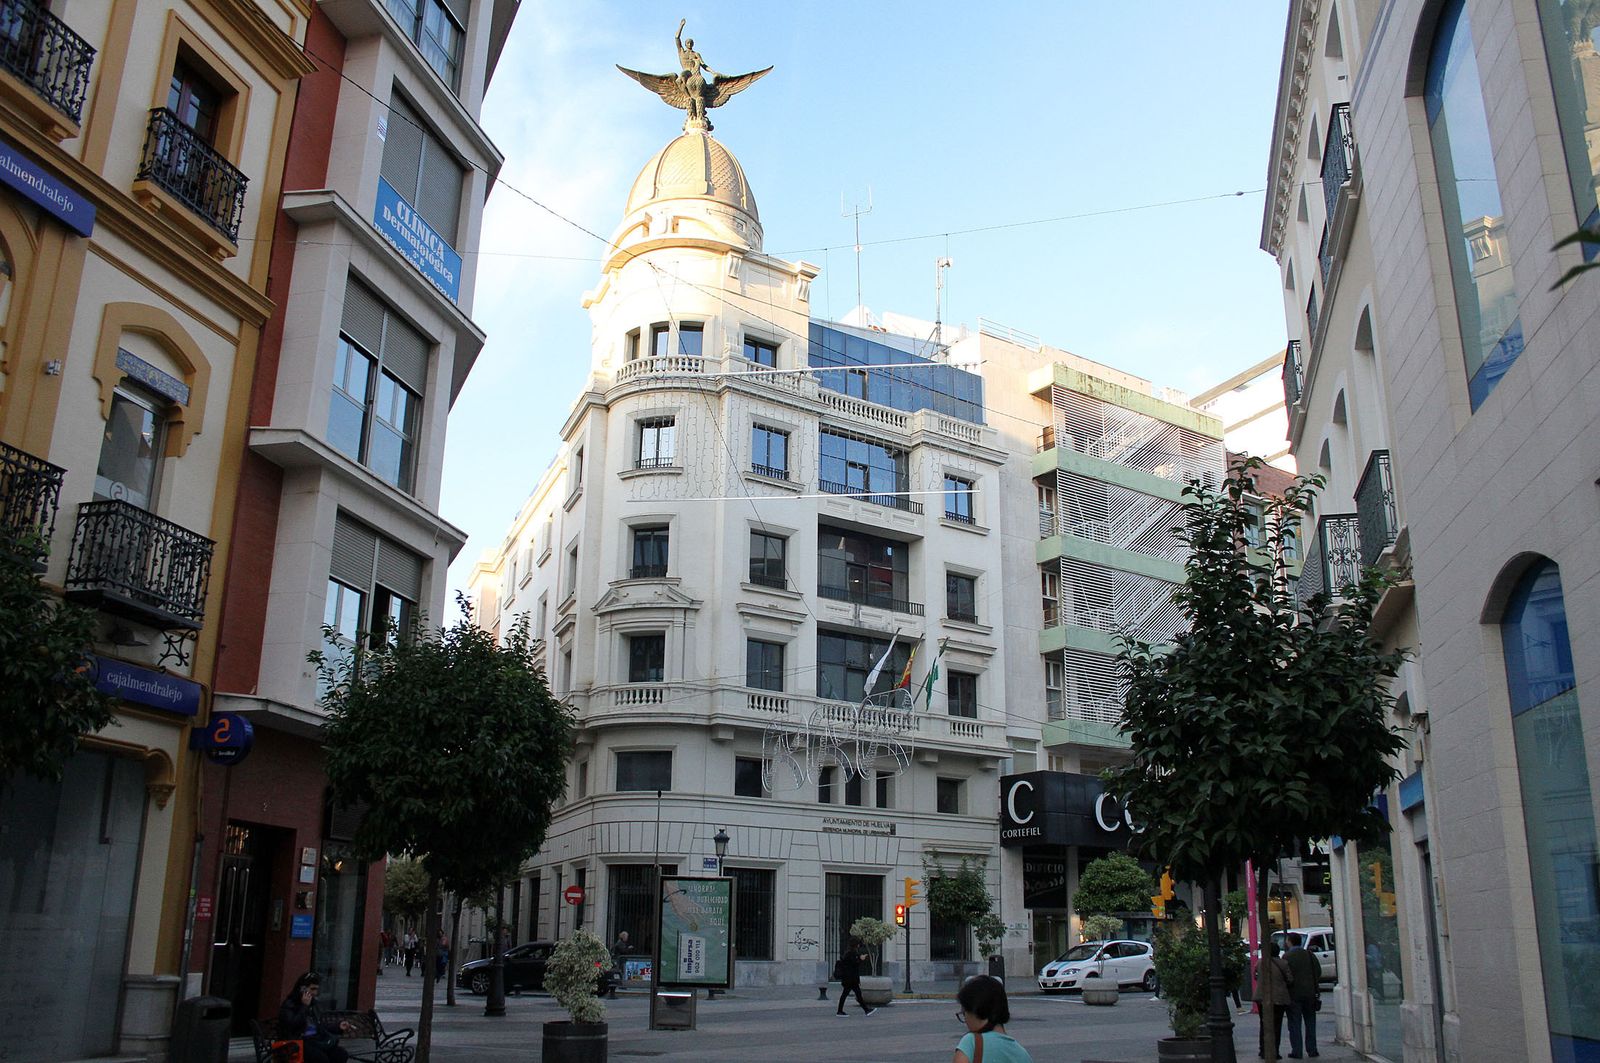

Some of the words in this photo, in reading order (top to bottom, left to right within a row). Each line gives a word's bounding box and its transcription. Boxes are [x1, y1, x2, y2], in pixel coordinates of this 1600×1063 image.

[383, 205, 453, 284] Dermatológica
[396, 201, 445, 261] CLÍNICA
[106, 671, 183, 704] cajalmendralejo
[1007, 780, 1035, 825] C
[822, 817, 862, 826] AYUNTAMIENTO
[863, 819, 870, 827] DE
[871, 820, 891, 828] HUELVA
[1002, 827, 1042, 839] CORTEFIEL
